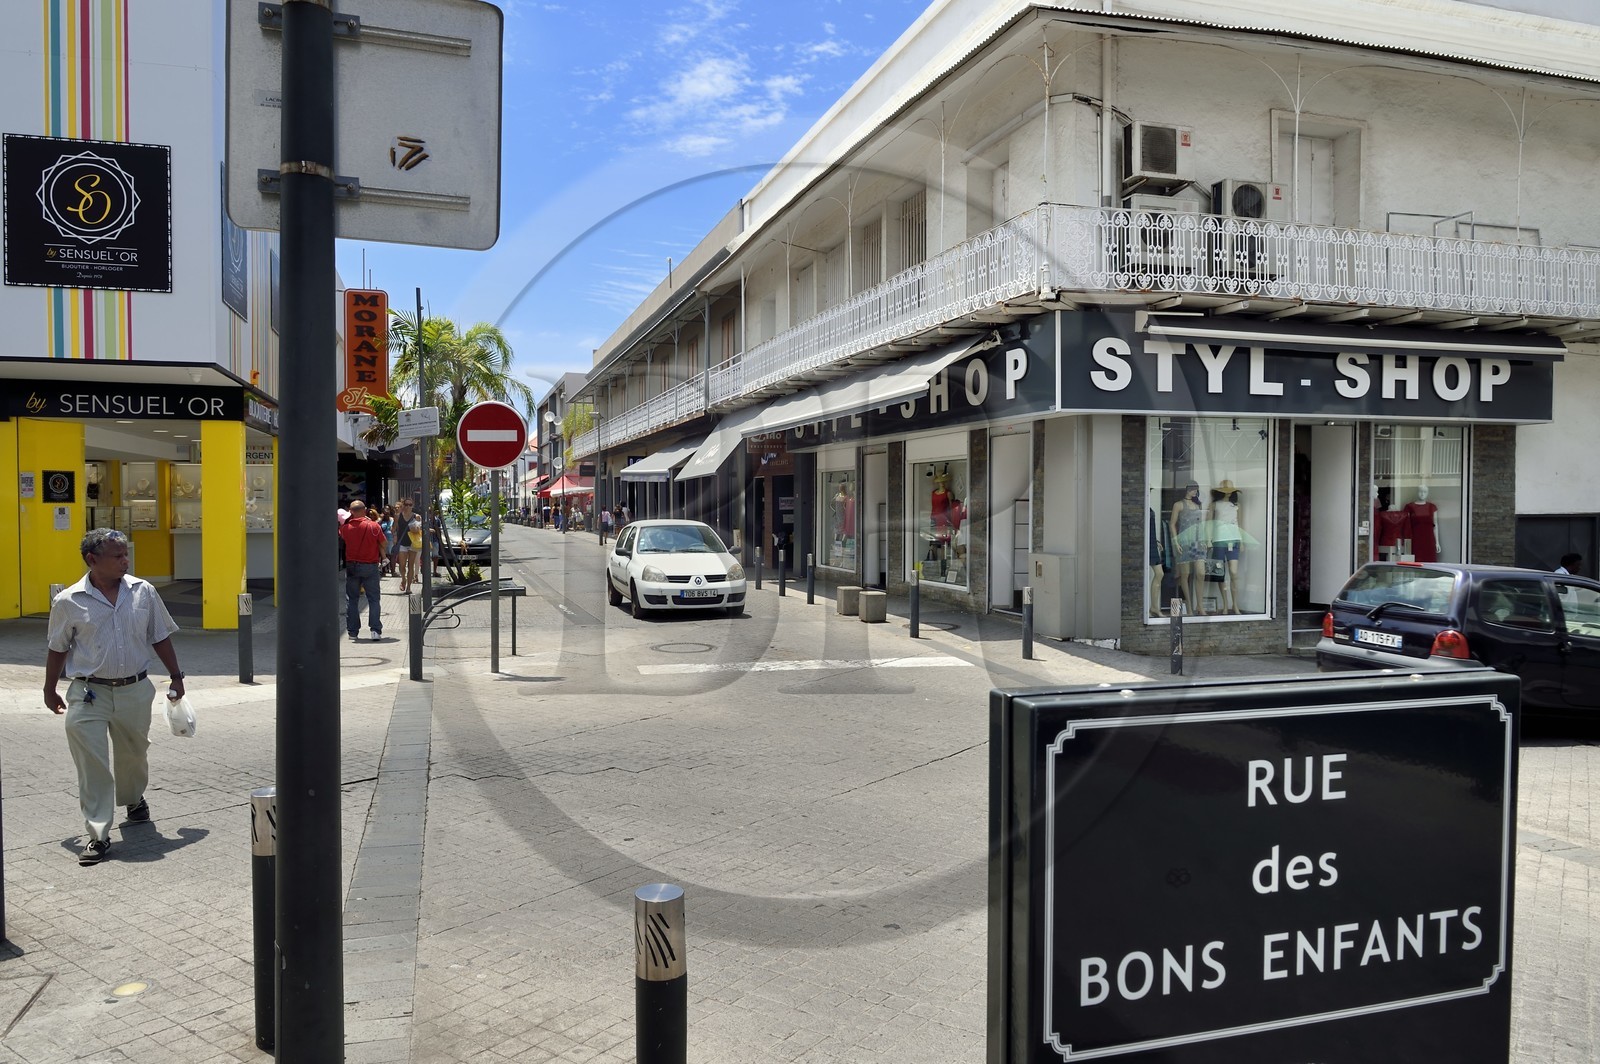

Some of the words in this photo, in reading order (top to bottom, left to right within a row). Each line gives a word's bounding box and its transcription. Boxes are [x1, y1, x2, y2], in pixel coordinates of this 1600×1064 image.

[46, 247, 57, 258] by
[353, 294, 380, 383] MORANE
[1090, 337, 1284, 396] STYL
[1334, 351, 1511, 402] SHOP
[25, 391, 48, 414] by
[1247, 753, 1347, 807] RUE
[1252, 844, 1339, 895] des
[1080, 940, 1227, 1006] BONS
[1263, 905, 1482, 981] ENFANTS
